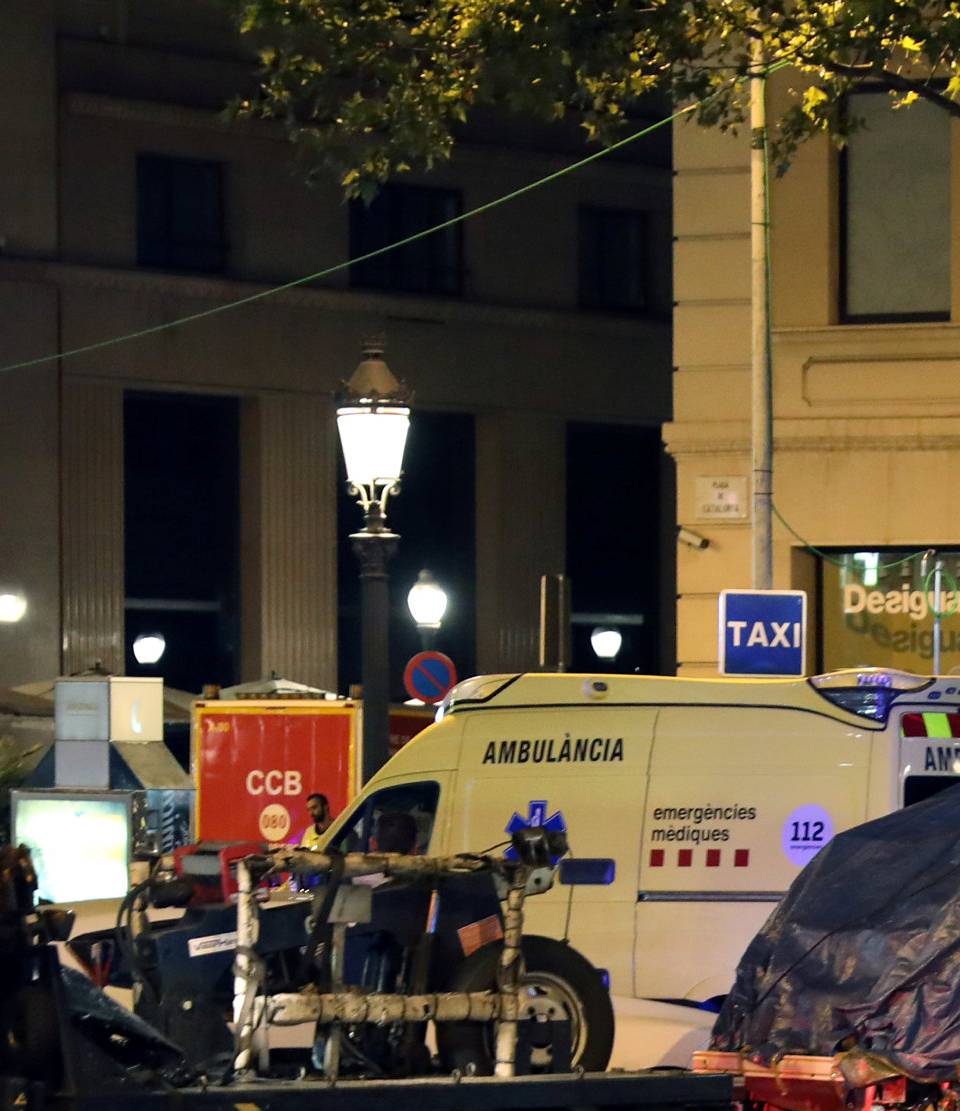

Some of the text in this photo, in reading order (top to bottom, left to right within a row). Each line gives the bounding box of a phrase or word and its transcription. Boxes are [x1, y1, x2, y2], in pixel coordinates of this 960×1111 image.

[727, 621, 800, 648] TAXI
[482, 732, 624, 764] AMBULÀNCIA
[246, 769, 303, 796] CCB
[262, 813, 287, 829] 080
[653, 803, 757, 824] emergències
[651, 825, 730, 845] mèdiques
[790, 821, 824, 841] 112
